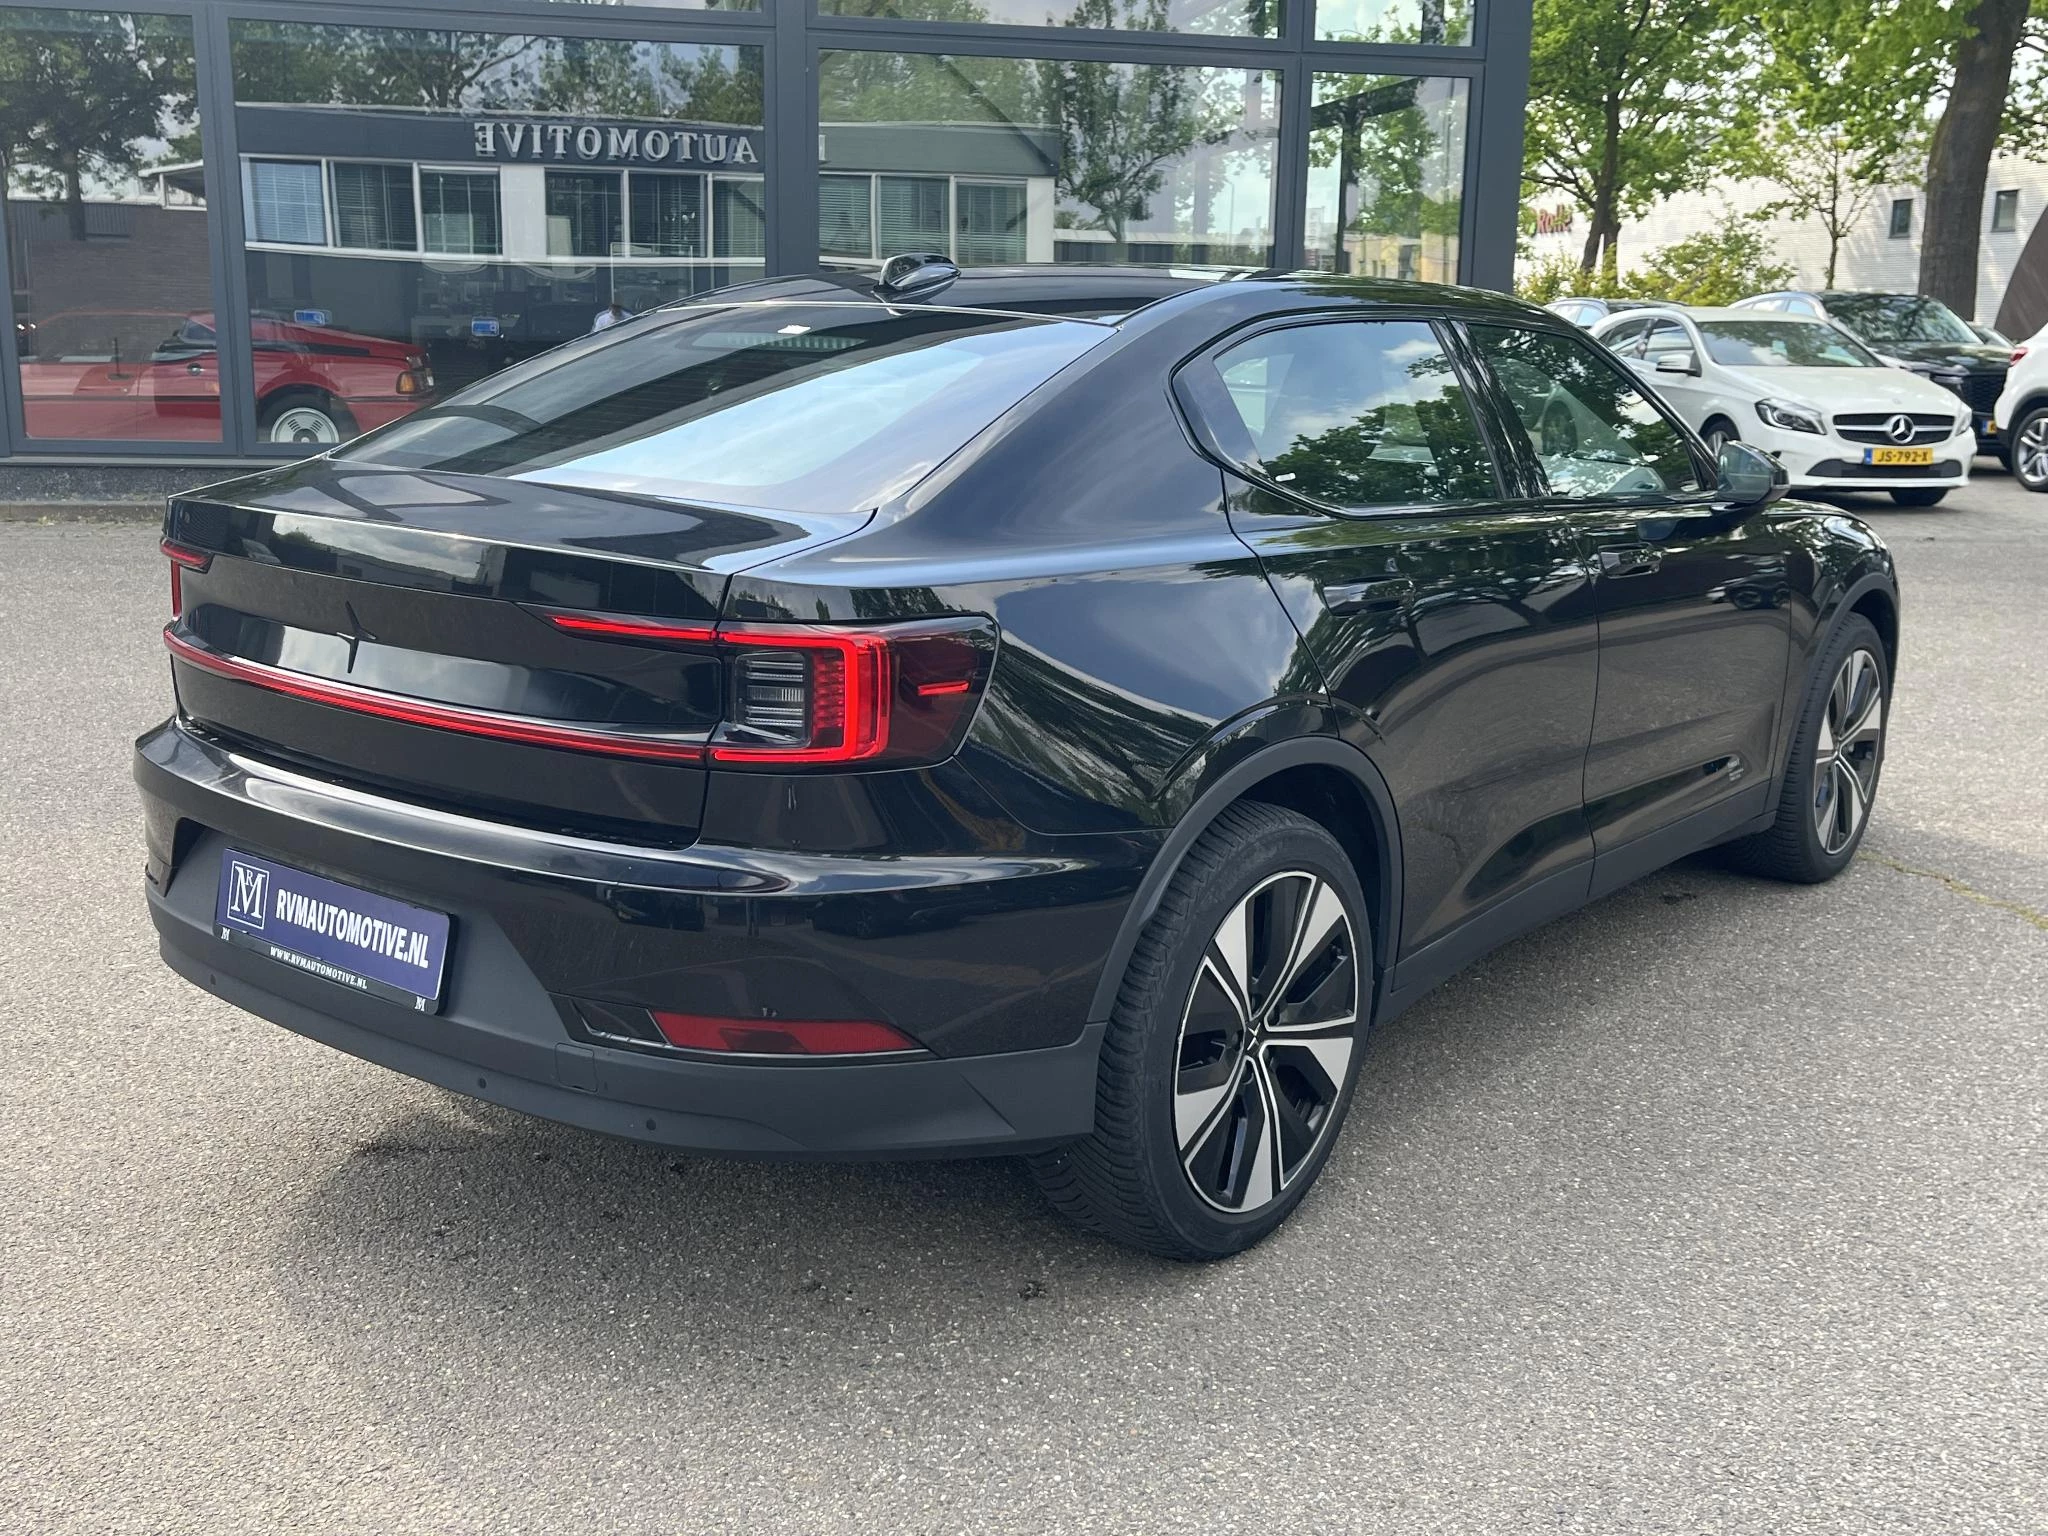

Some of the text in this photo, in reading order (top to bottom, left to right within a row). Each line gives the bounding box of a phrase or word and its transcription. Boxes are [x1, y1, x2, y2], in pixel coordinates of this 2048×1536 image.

[1877, 450, 1929, 463] JS-792-X
[275, 888, 429, 969] RVMAUTOMOTIVE.NL
[269, 945, 368, 990] WWW.RVMAUTOMOTIVE.NL
